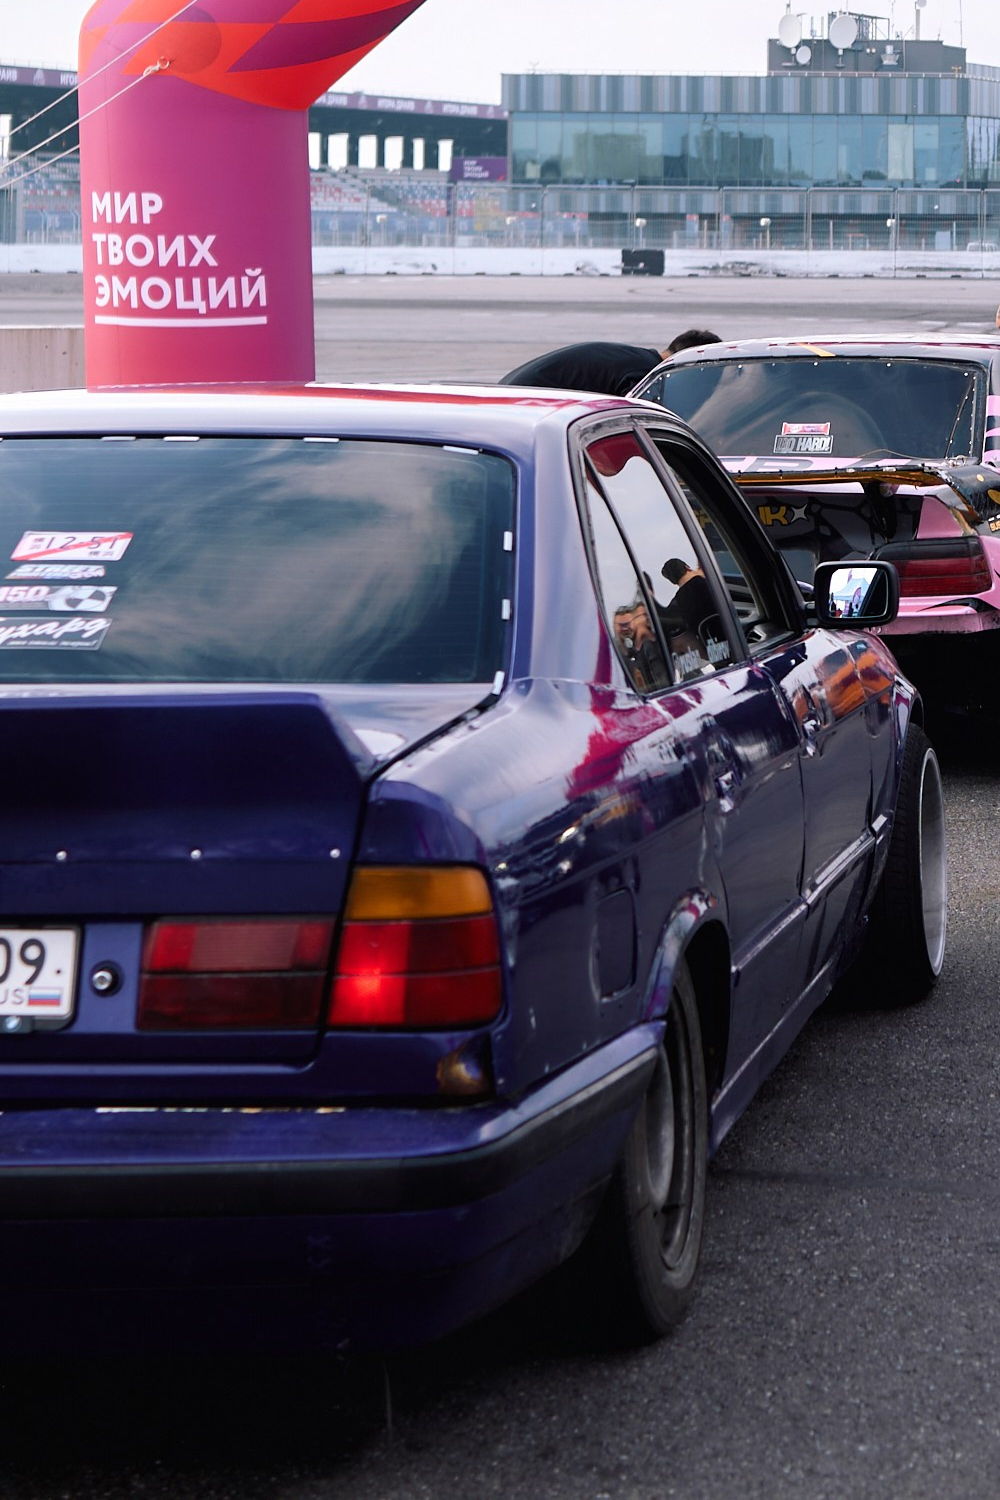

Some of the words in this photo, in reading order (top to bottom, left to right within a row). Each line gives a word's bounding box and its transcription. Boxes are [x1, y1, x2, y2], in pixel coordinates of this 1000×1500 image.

[92, 192, 163, 224] МИР
[92, 233, 218, 267] ТВОИХ
[94, 268, 268, 314] ЭМОЦИЙ
[796, 436, 831, 451] HARD!
[0, 988, 24, 1005] US
